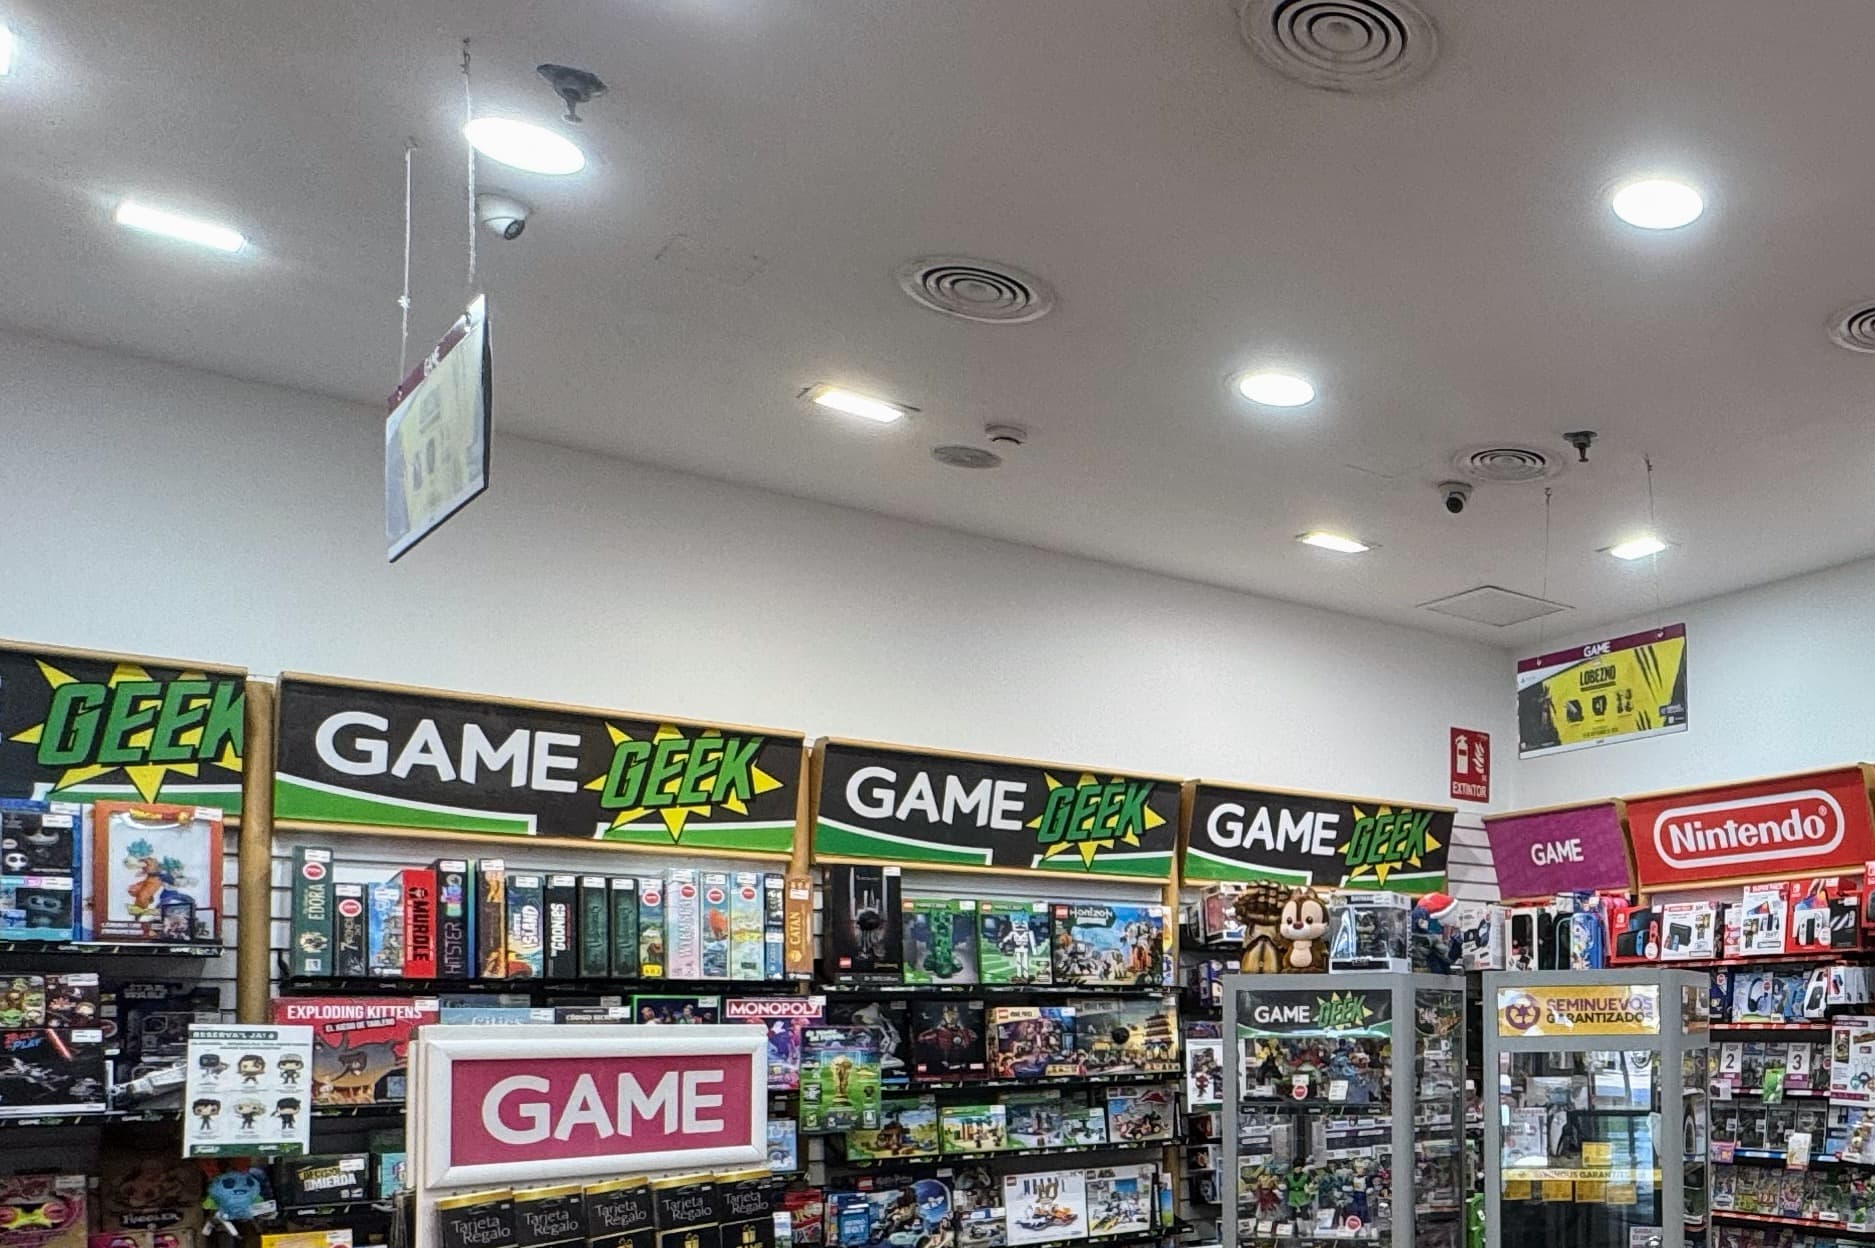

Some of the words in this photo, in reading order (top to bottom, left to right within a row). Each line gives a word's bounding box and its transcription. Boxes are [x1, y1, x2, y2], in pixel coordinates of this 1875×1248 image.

[1584, 642, 1611, 657] GAME
[1580, 665, 1616, 686] LOBEZNO
[37, 681, 244, 765] GEEK
[316, 712, 580, 792] GAME
[601, 738, 762, 809] GEEK
[1453, 782, 1487, 797] EXTINTOR
[845, 767, 1026, 831] GAME
[1038, 781, 1155, 843] GEEK
[1207, 804, 1339, 855] GAME
[1346, 809, 1431, 868] GEEK
[1668, 808, 1825, 854] Nintendo
[1531, 839, 1584, 865] GAME
[309, 884, 325, 920] EDORA
[412, 901, 430, 961] MURDLE
[523, 905, 540, 947] ISLAND
[789, 912, 800, 945] CATAN
[444, 922, 463, 974] HITSTER
[288, 1005, 364, 1019] EXPLODING
[367, 1005, 421, 1019] KITTENS
[730, 1002, 818, 1015] MONOPOLY
[1254, 1006, 1309, 1024] GAME
[1318, 996, 1363, 1026] GEEK
[1547, 998, 1652, 1011] SEMINUEVOS
[1546, 1011, 1654, 1024] GARANTIZADOS
[1726, 1054, 1734, 1069] 2
[1793, 1054, 1802, 1070] 3
[481, 1070, 725, 1145] GAME
[451, 1217, 500, 1233] Tarjeta
[524, 1210, 569, 1226] Tarjeta
[533, 1219, 578, 1236] Regalo
[464, 1226, 511, 1244] Regalo
